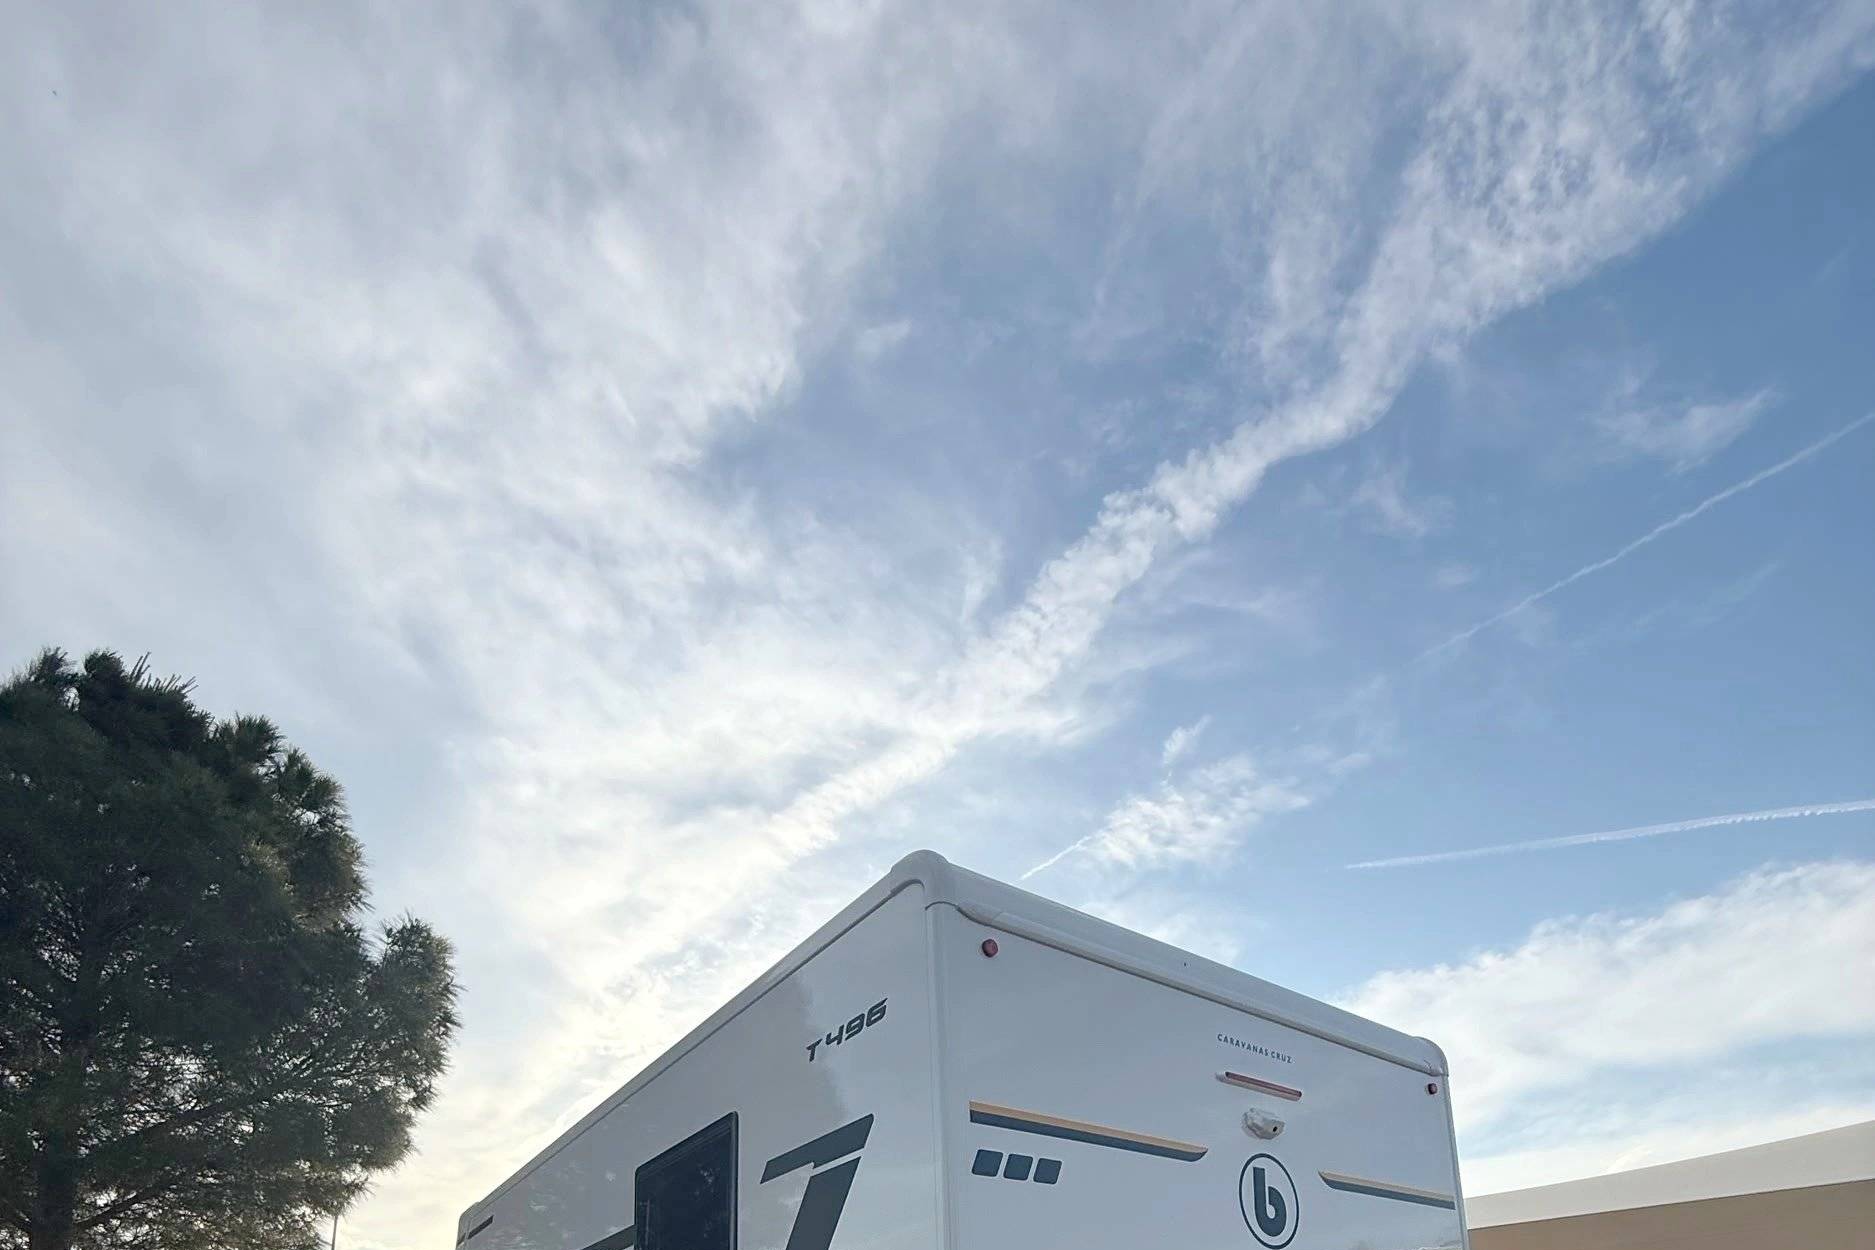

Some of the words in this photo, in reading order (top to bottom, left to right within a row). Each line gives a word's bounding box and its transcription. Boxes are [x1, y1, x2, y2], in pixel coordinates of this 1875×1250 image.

[806, 1038, 823, 1062] T
[825, 997, 888, 1046] 496
[1217, 1033, 1269, 1057] CARAVANAS
[1271, 1050, 1293, 1064] CRUZ
